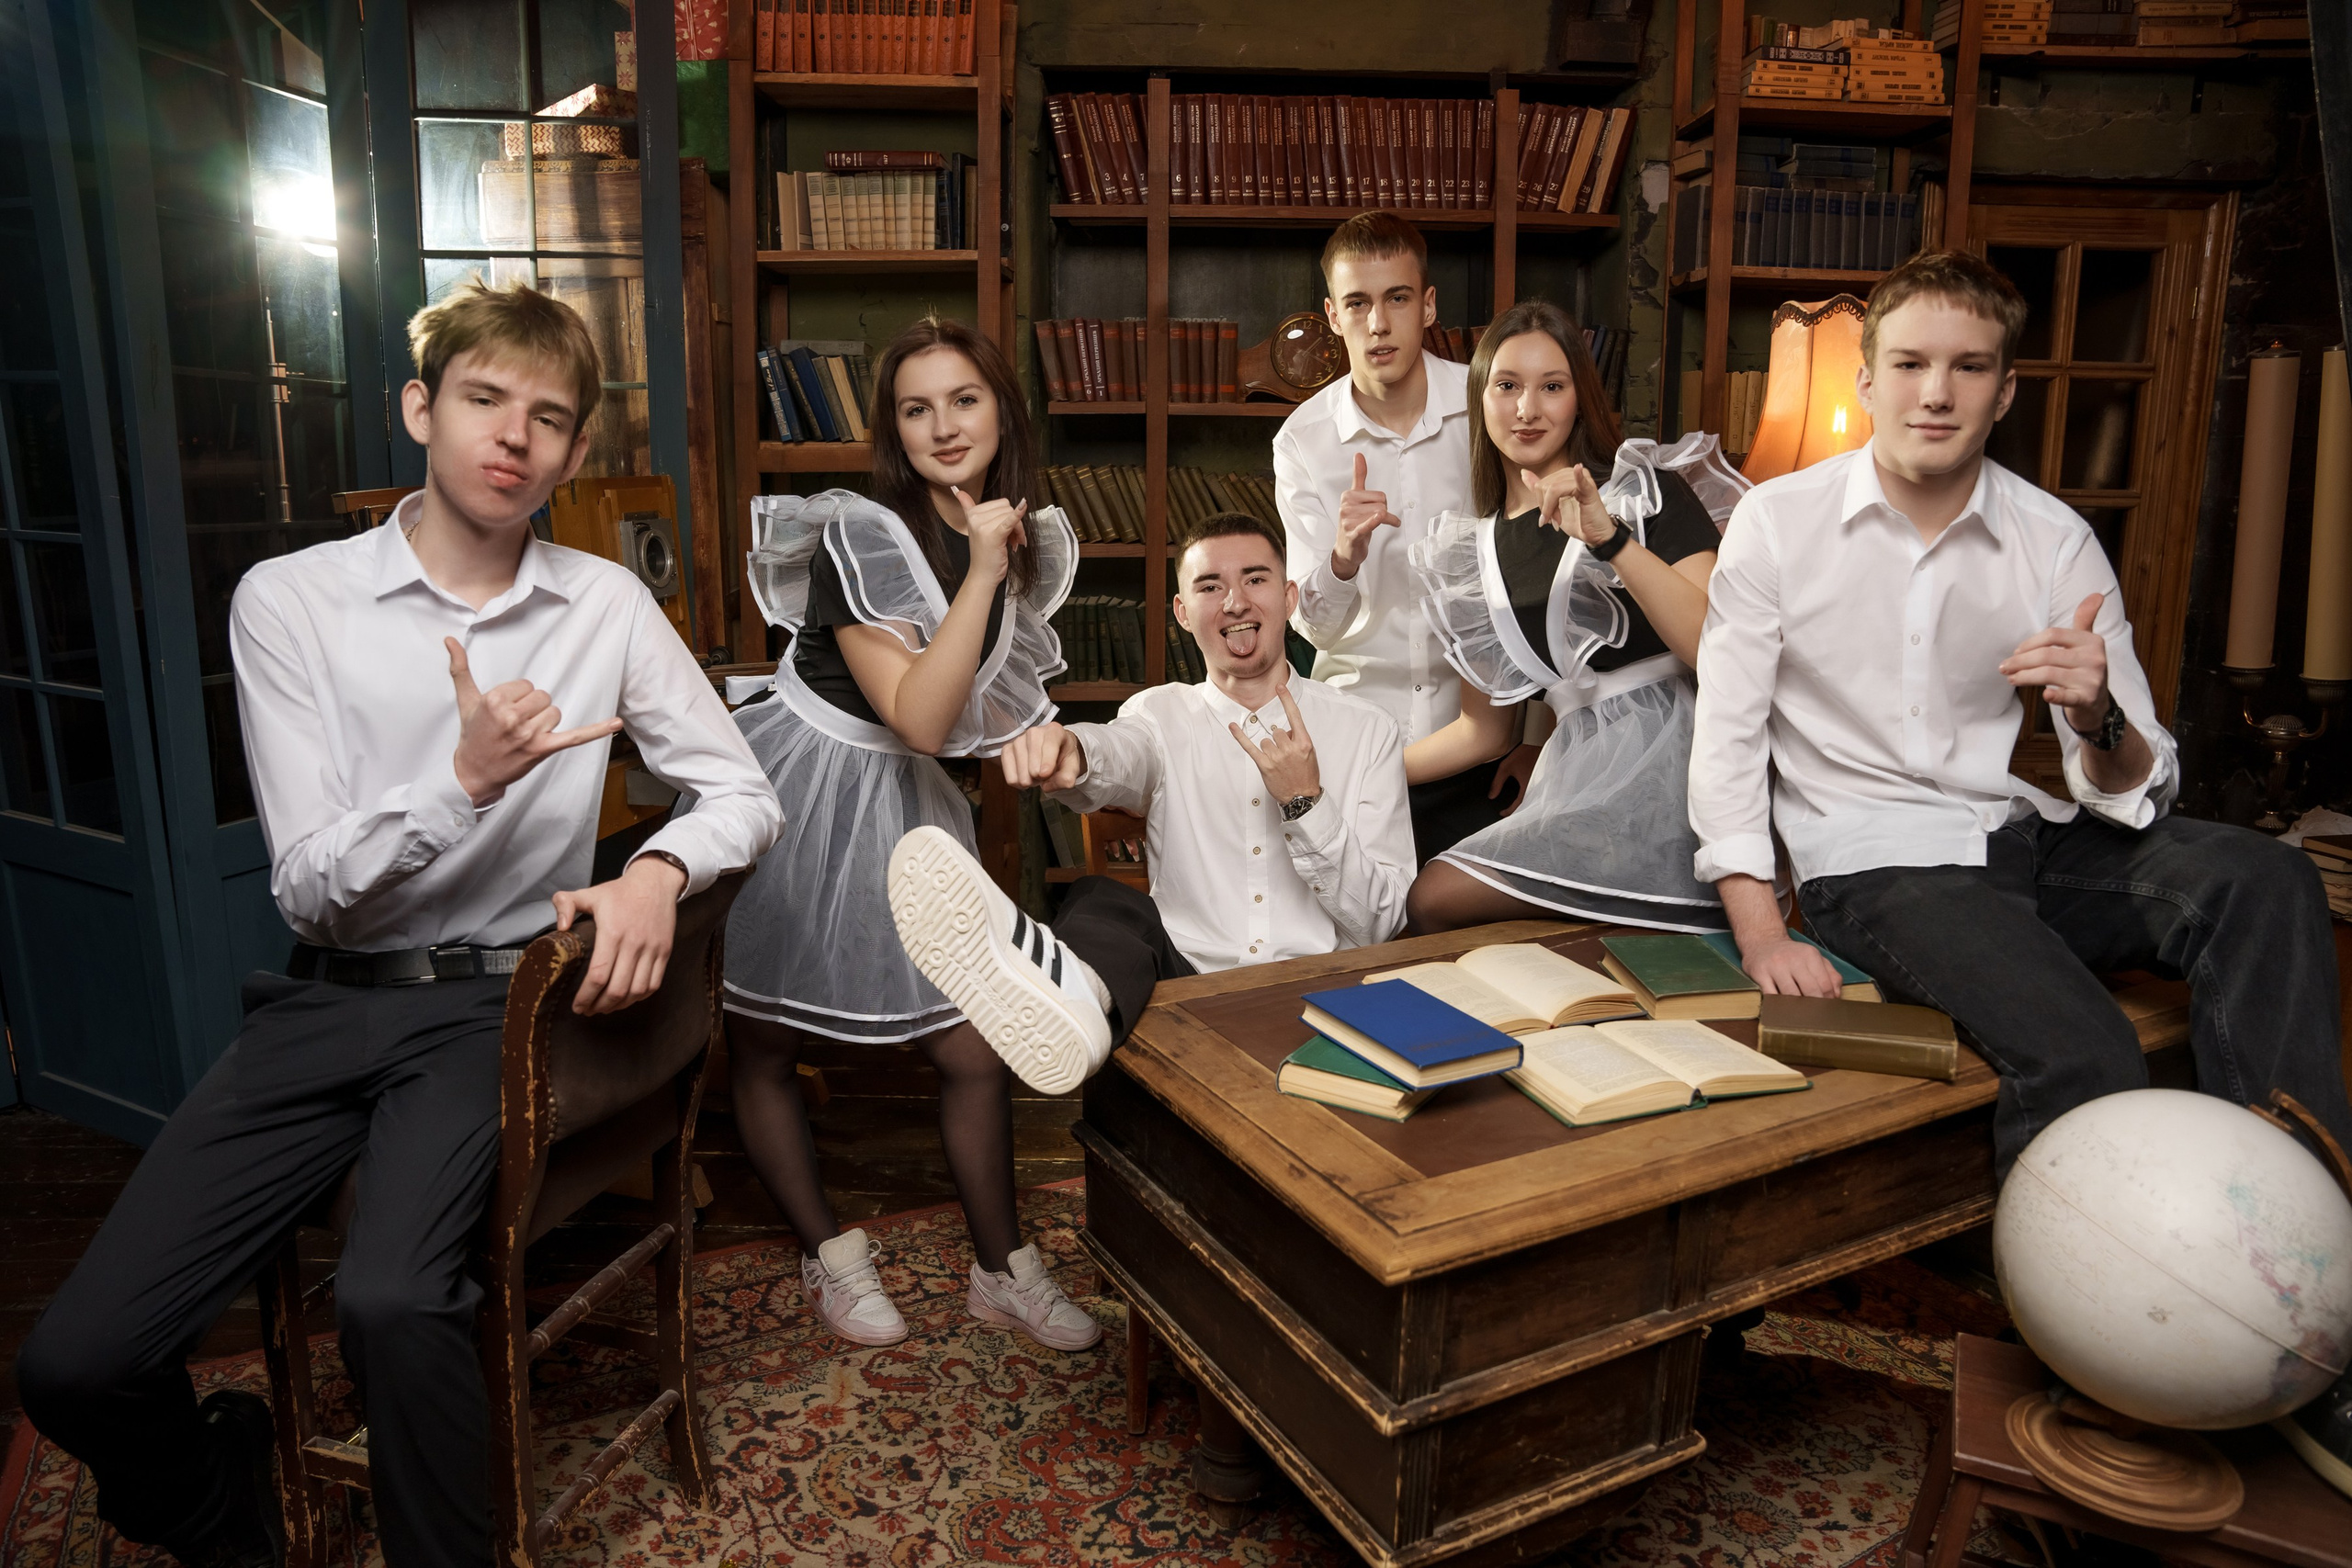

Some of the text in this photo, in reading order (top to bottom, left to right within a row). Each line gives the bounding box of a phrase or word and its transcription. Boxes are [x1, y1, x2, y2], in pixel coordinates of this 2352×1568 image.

[1104, 173, 1111, 181] 3
[1294, 176, 1301, 185] 13
[1329, 176, 1336, 185] 15
[1347, 176, 1354, 185] 16
[1380, 178, 1388, 186] 18
[1411, 178, 1420, 186] 20
[1427, 179, 1436, 187] 21
[1445, 179, 1454, 187] 22
[1518, 180, 1528, 188] 25
[1532, 183, 1543, 192] 26
[1549, 183, 1559, 191] 27
[1582, 185, 1591, 194] 29
[1302, 321, 1312, 329] 12
[1318, 325, 1323, 333] 1
[1279, 333, 1287, 342] 10
[1327, 334, 1335, 344] 2
[1274, 347, 1283, 355] 9
[1330, 349, 1338, 358] 3
[1325, 362, 1333, 373] 4
[1287, 371, 1295, 380] 7
[1316, 372, 1322, 382] 5
